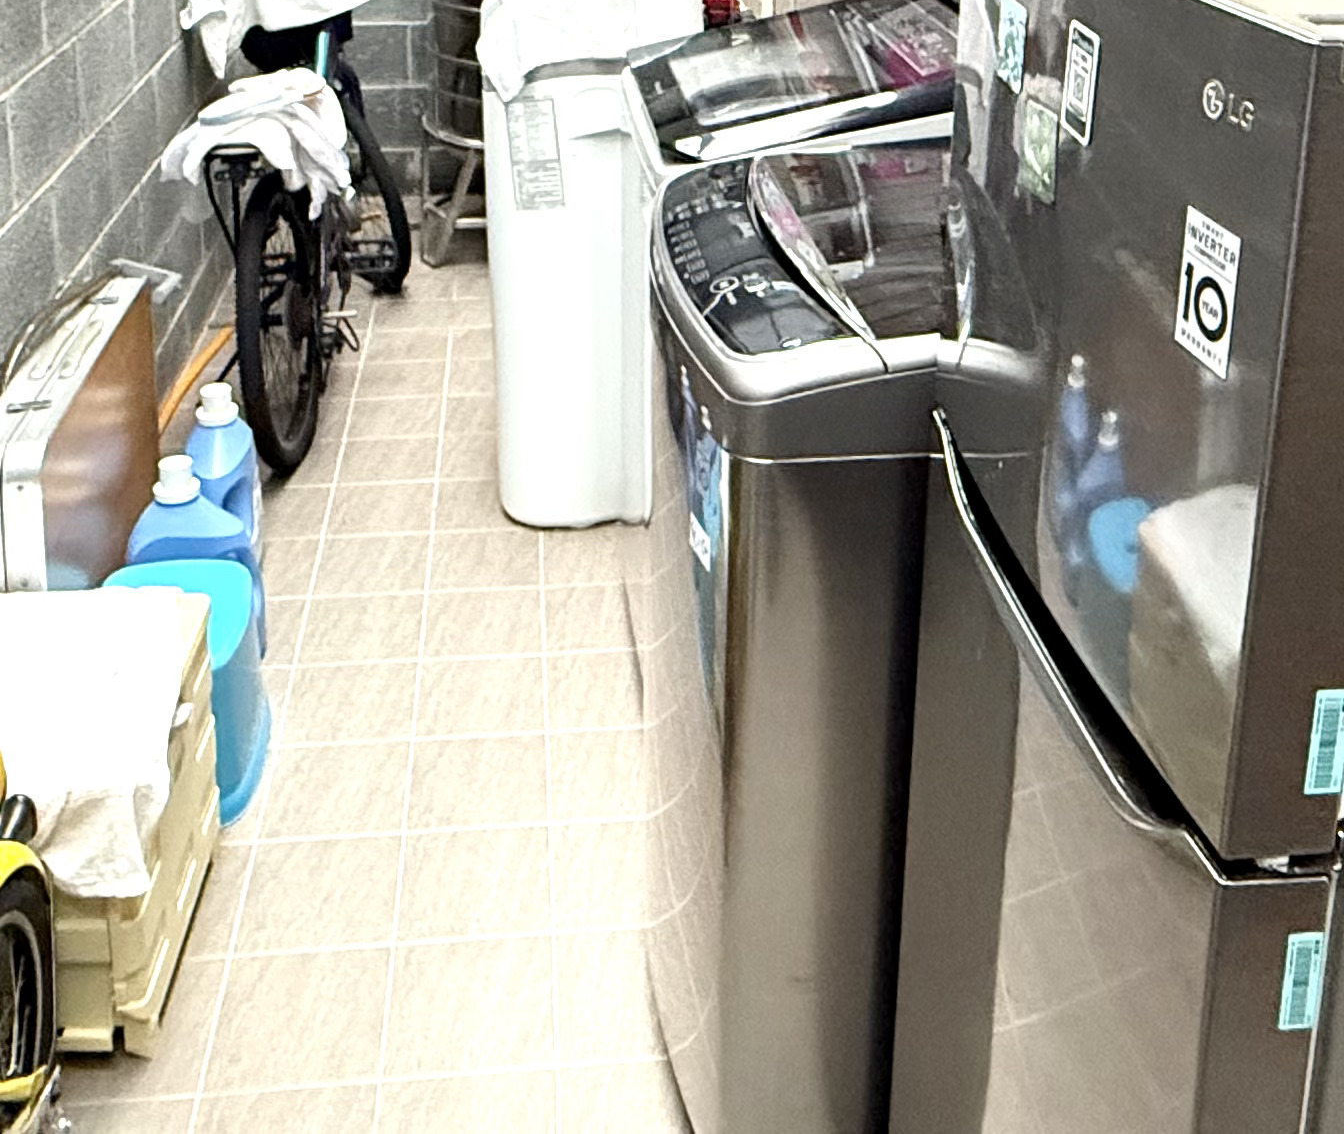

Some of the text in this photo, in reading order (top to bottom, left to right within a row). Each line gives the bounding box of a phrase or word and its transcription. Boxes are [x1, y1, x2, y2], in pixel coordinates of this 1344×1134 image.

[1227, 93, 1255, 132] LG
[1187, 222, 1236, 267] INVERTER
[1182, 261, 1228, 343] 10
[1201, 299, 1219, 320] YEAR
